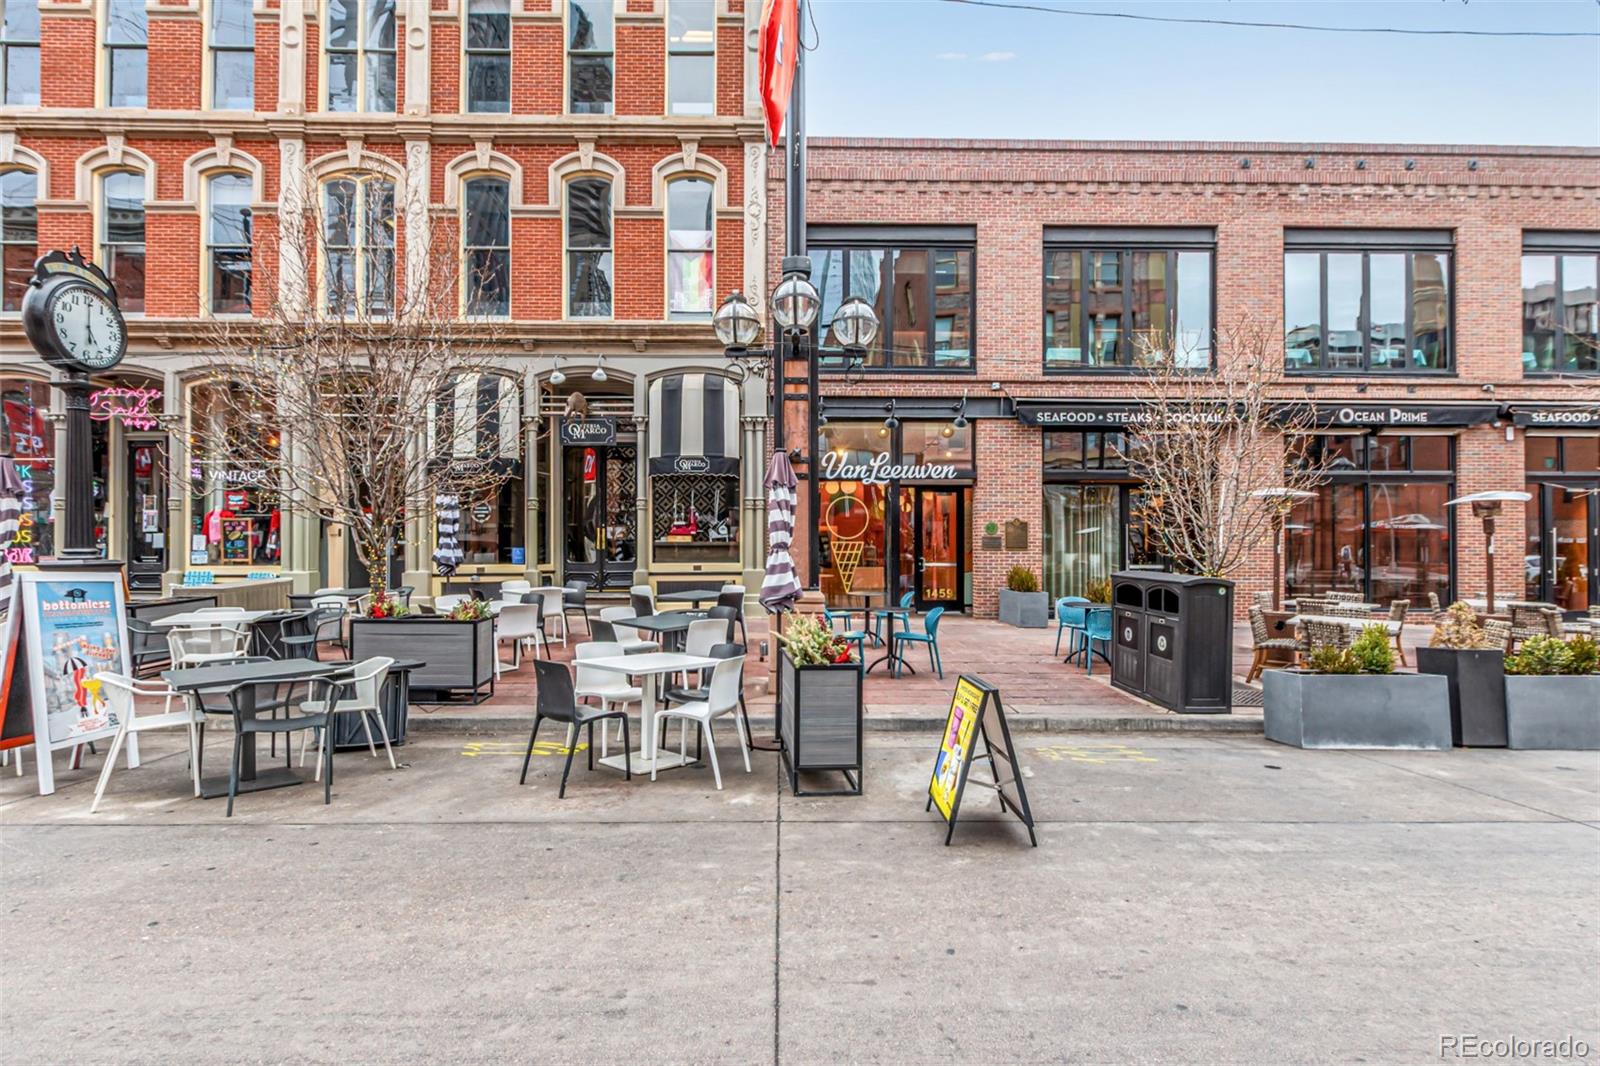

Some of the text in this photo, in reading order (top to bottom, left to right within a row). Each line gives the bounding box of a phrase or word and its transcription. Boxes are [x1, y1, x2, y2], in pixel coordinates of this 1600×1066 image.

[62, 301, 72, 312] 10
[56, 313, 64, 323] 9
[60, 328, 68, 339] 8
[69, 341, 76, 352] 7
[82, 350, 91, 361] 6
[1036, 411, 1096, 423] SEAFOOD
[1106, 411, 1152, 423] STEAKS
[1532, 412, 1591, 423] SEAFOOD
[209, 469, 266, 482] VINTAGE
[925, 588, 953, 599] 1459
[42, 599, 111, 611] bottomless
